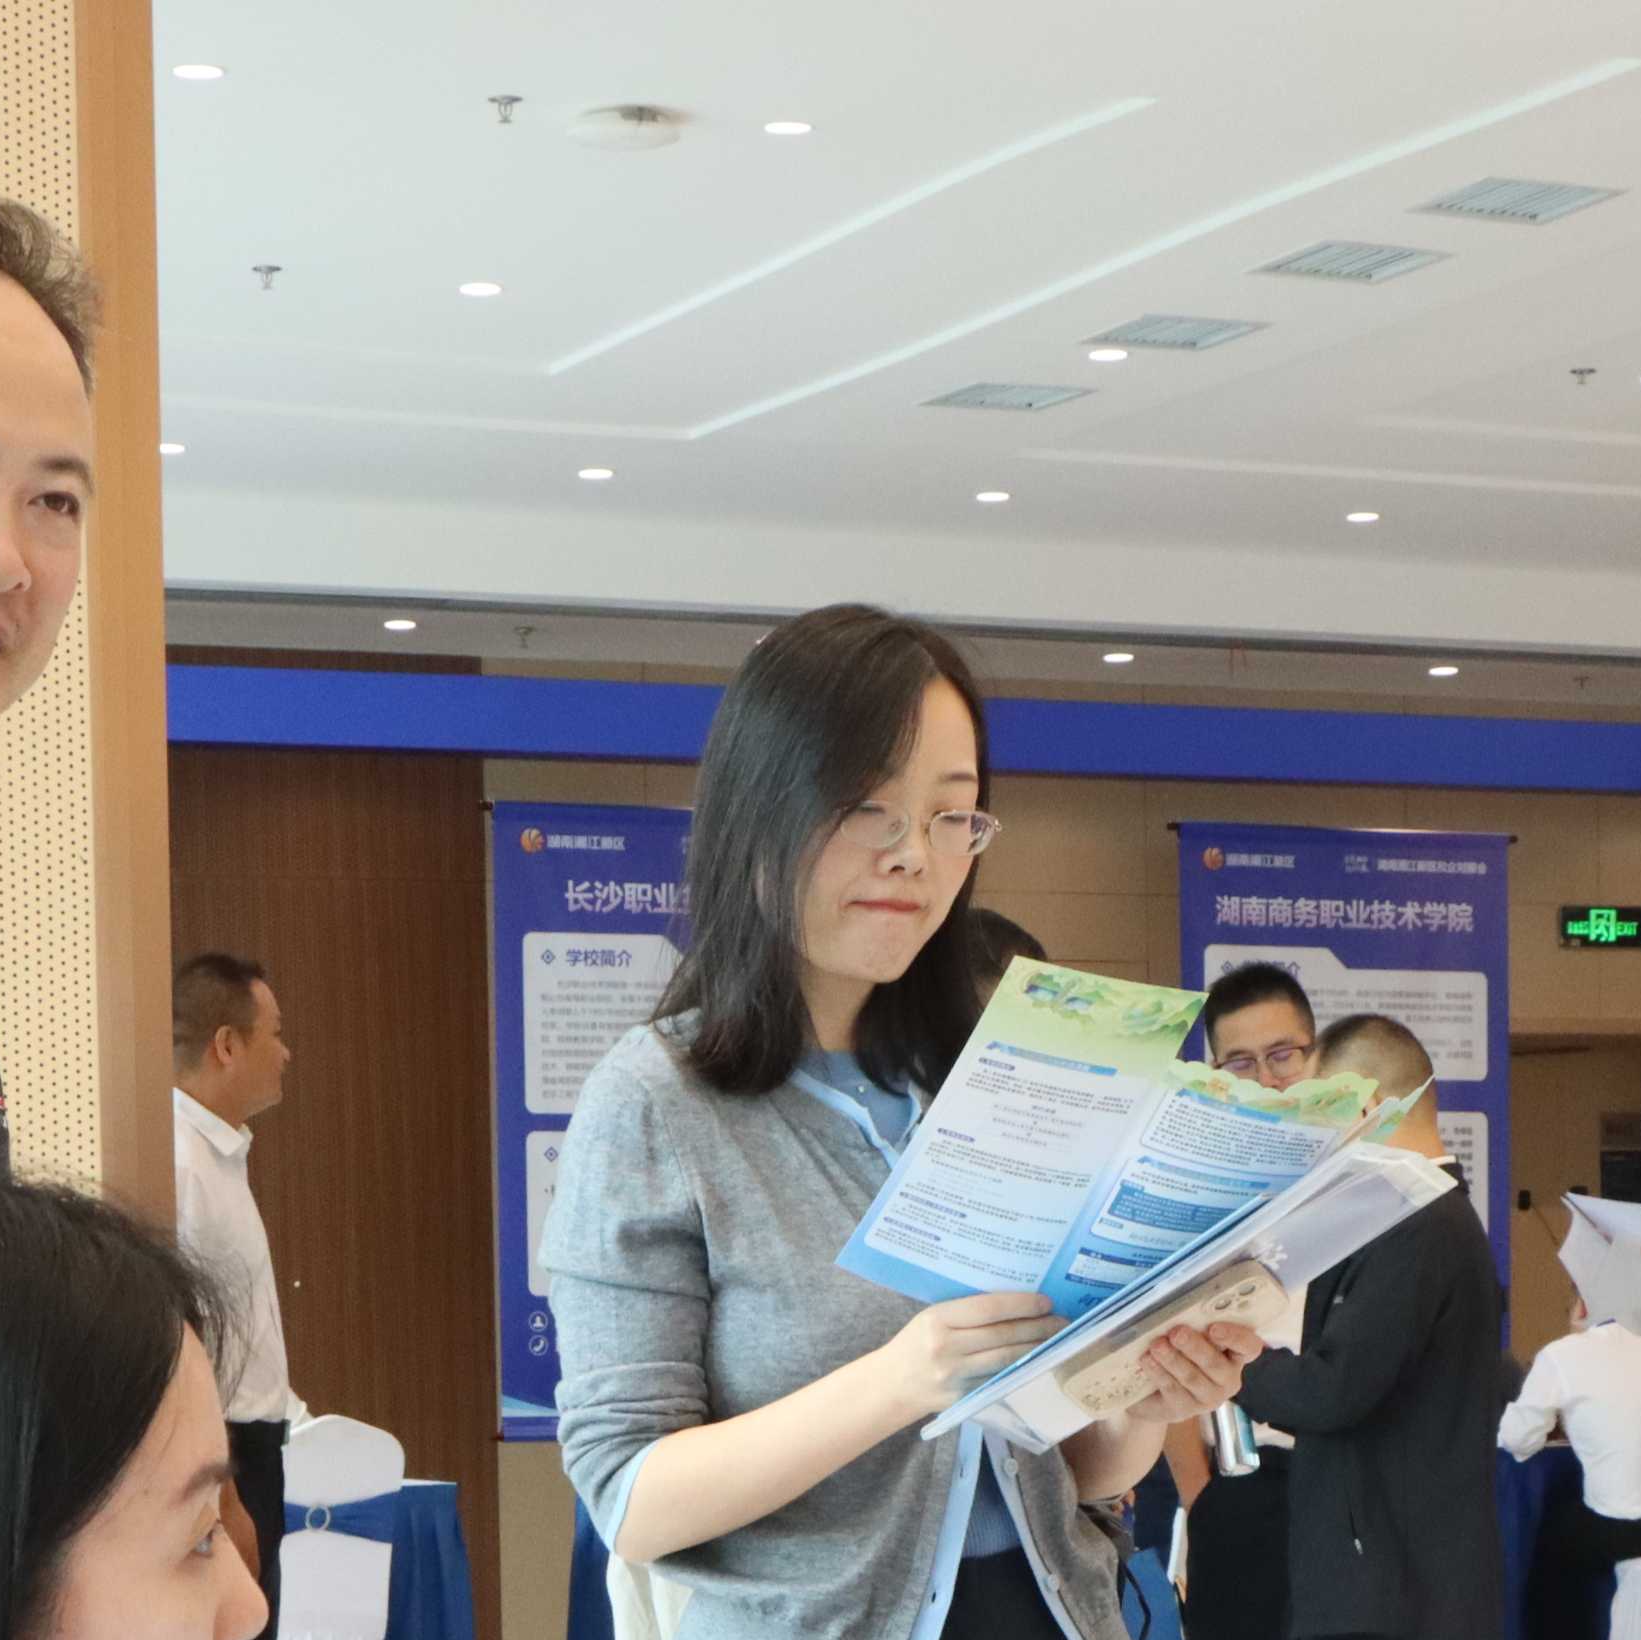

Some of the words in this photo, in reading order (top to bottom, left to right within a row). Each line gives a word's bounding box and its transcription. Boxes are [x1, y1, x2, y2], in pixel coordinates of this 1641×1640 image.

[1215, 895, 1475, 932] 湖南商务职业技术学院
[566, 949, 633, 968] 学校简介
